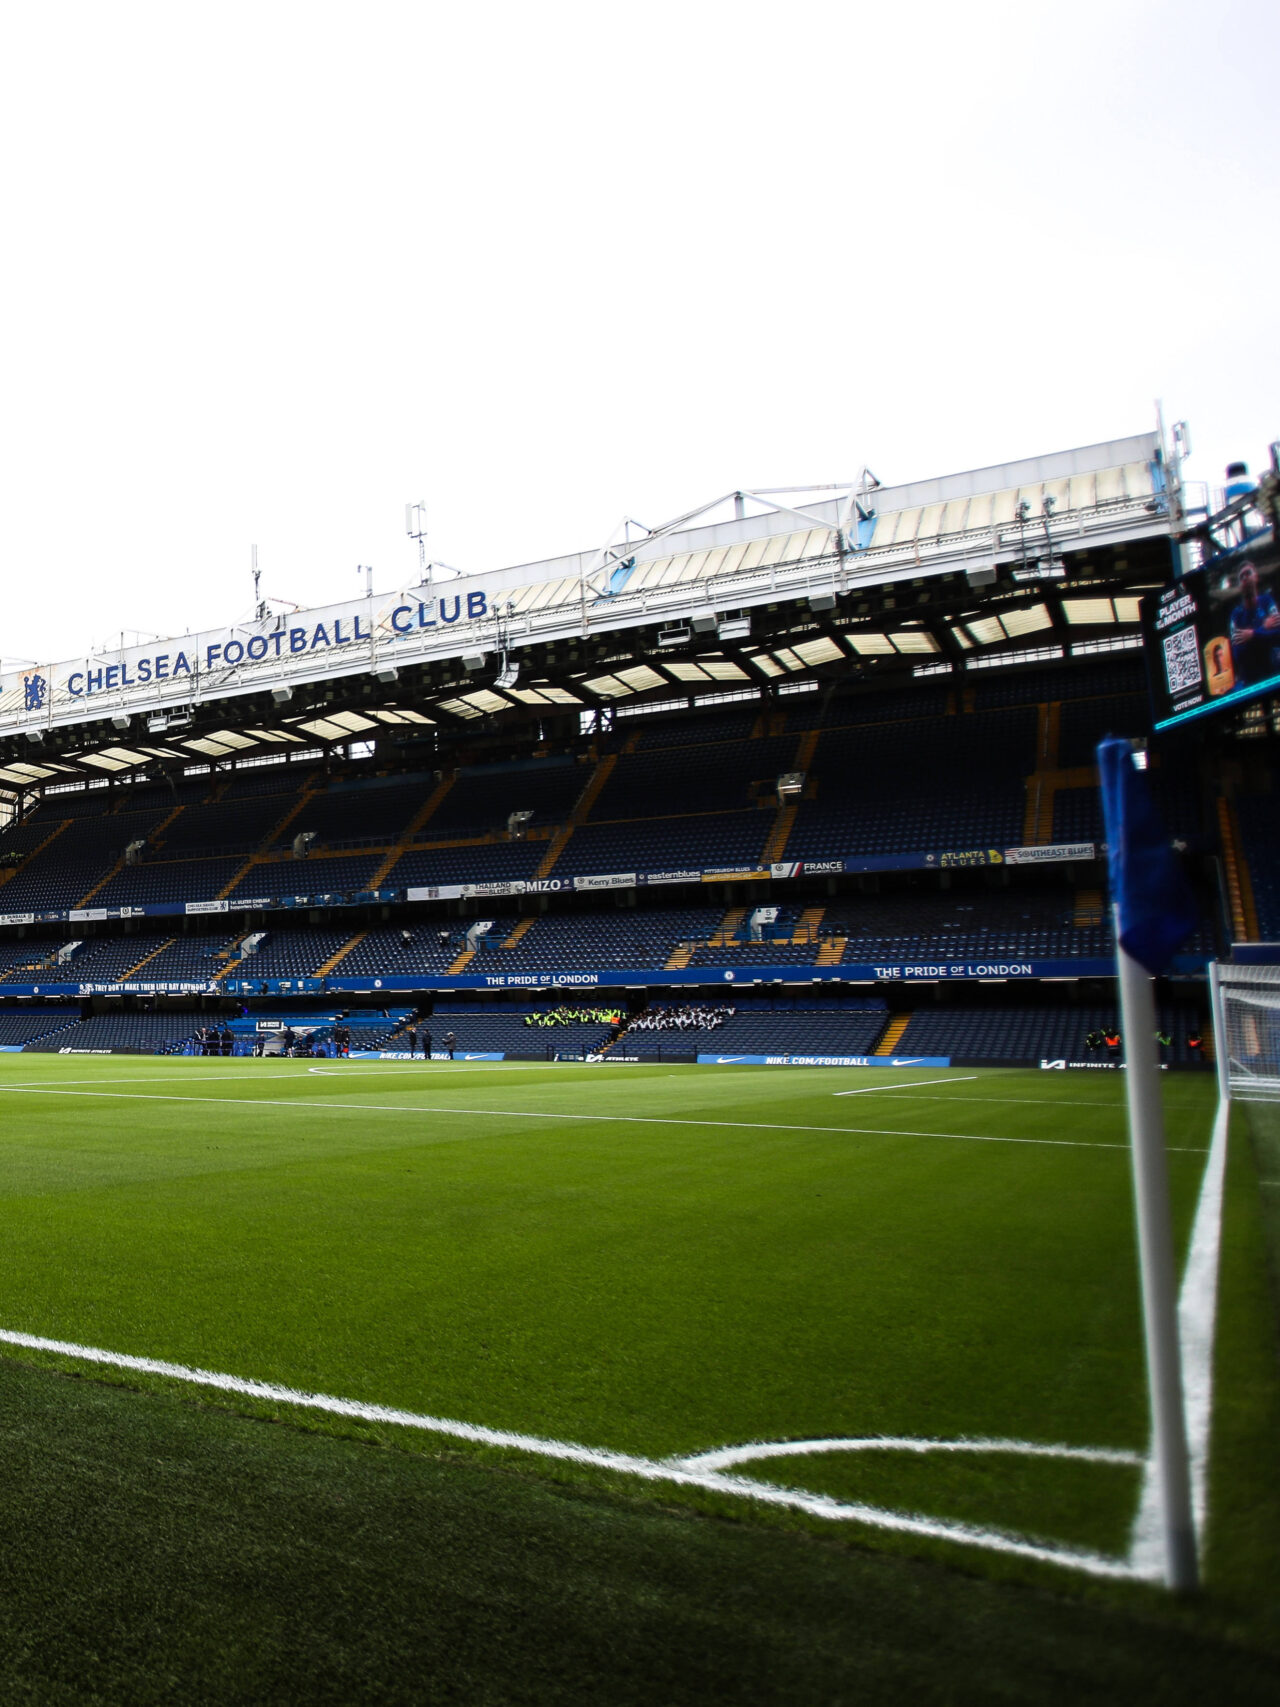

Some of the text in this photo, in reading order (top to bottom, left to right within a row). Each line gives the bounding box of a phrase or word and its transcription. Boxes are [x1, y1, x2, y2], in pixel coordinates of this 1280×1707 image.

[1159, 594, 1191, 618] PLAYER
[1164, 602, 1197, 625] MONTH
[68, 591, 488, 695] CHELSEA FOOTBALL CLUB
[941, 851, 985, 860] ATLANTA
[1068, 846, 1093, 855] BLUES
[804, 862, 842, 871] FRANCE
[941, 858, 985, 867] BLUES
[475, 881, 511, 889] THAILAND
[526, 879, 561, 892] MIZO
[588, 877, 634, 887] Kerry Blues
[874, 965, 1032, 977] THE PRIDE OF LONDON
[486, 974, 598, 985] THE PRIDE OF LONDON
[95, 984, 107, 992] THEY
[141, 983, 155, 991] THEM
[180, 982, 207, 991] ANYMORE
[766, 1056, 869, 1066] NIKE.COM/FOOTBALL
